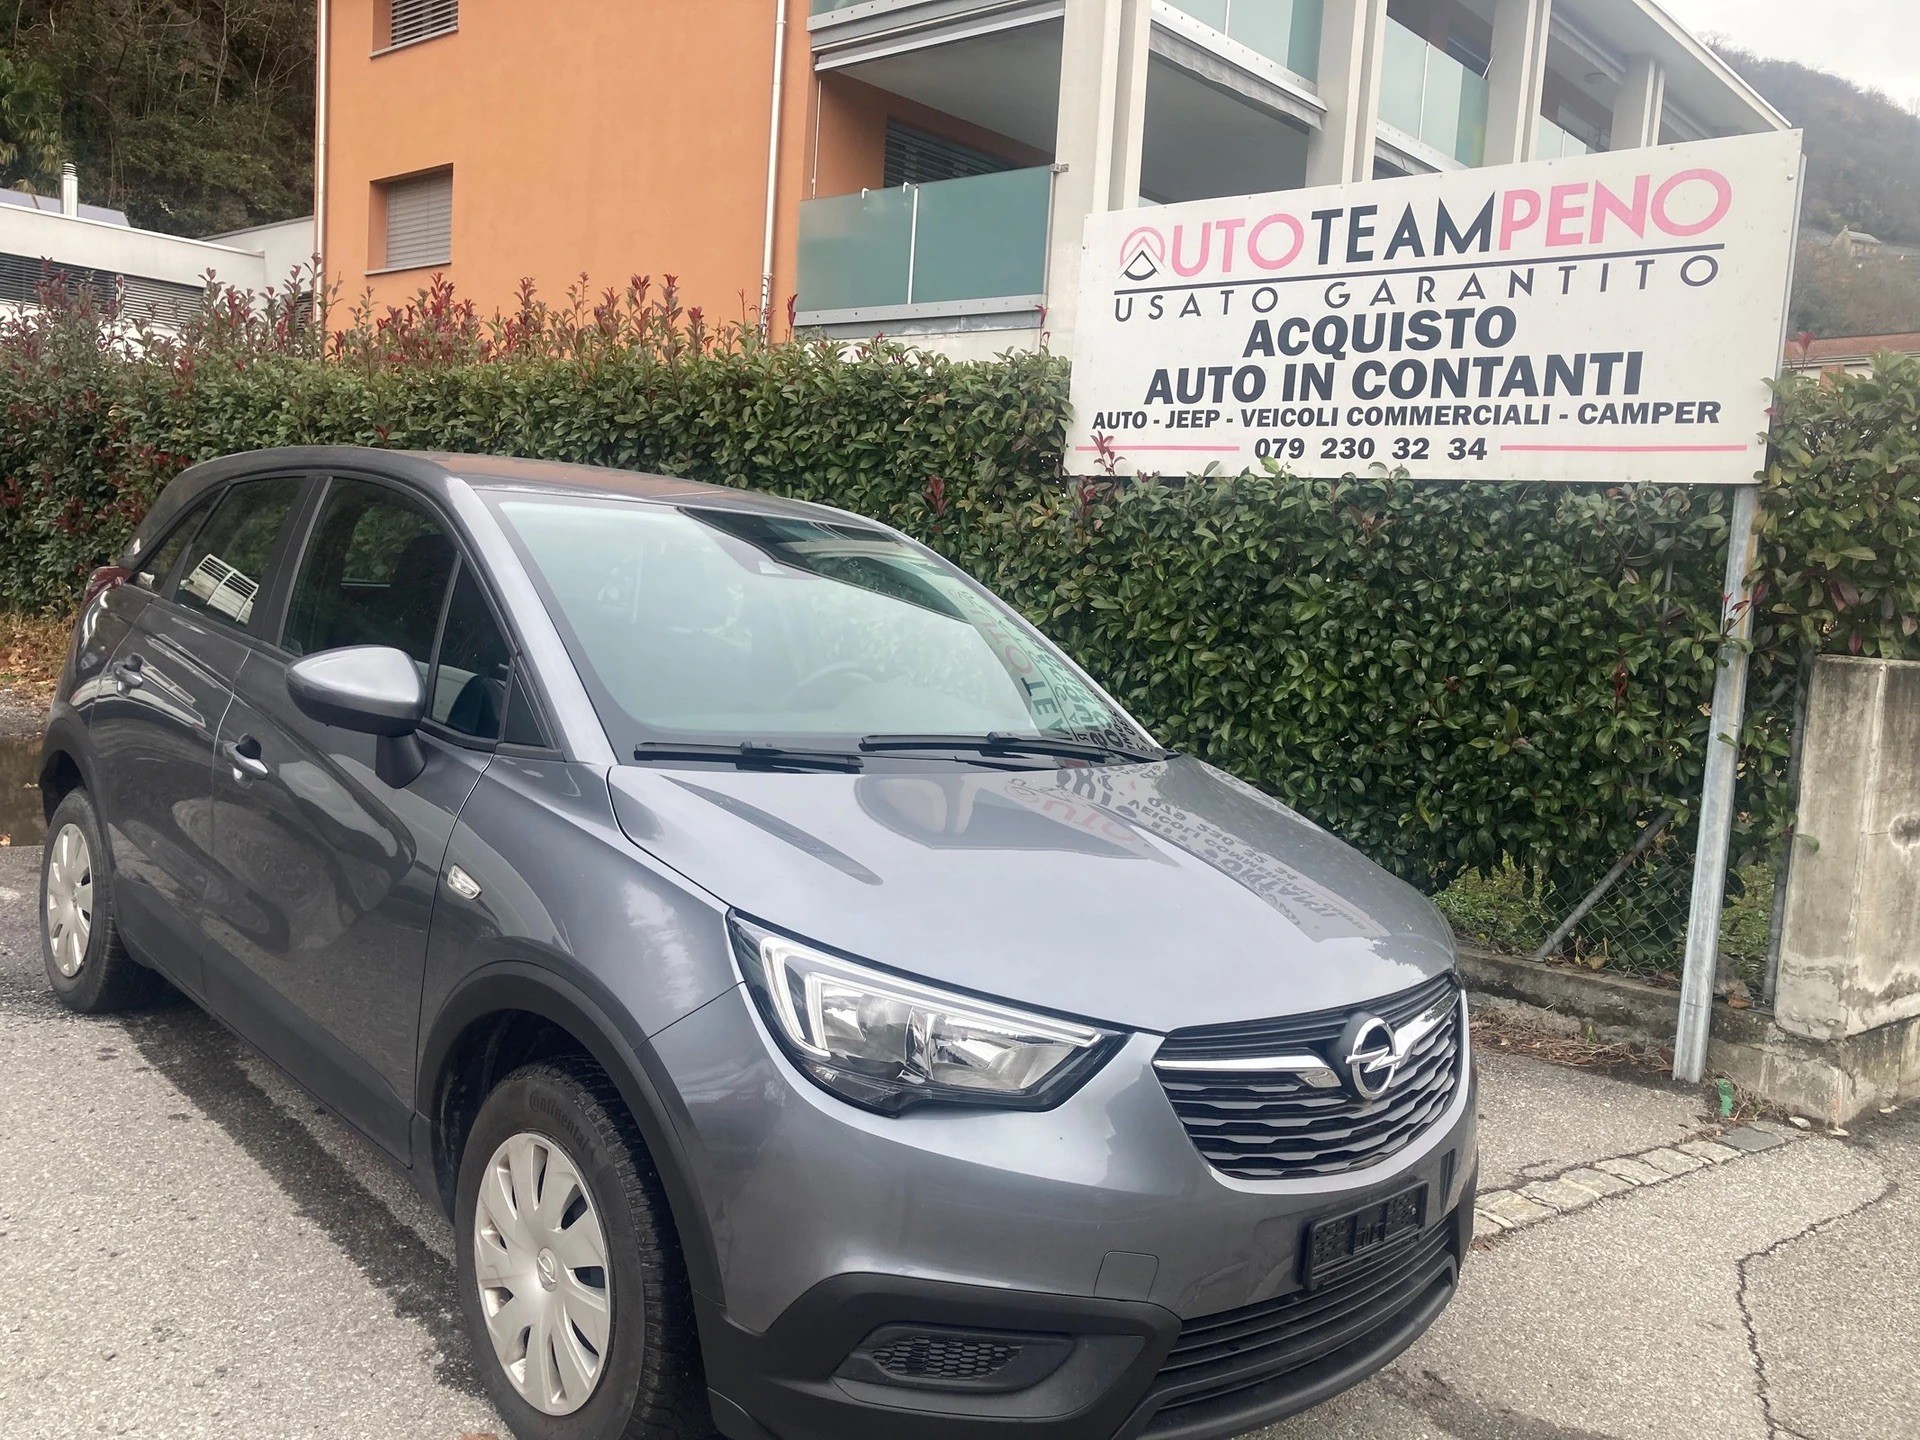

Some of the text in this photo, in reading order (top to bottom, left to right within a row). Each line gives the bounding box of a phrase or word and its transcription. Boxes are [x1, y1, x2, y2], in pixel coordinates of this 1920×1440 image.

[1114, 254, 1720, 323] USATO GARANTITO
[1242, 305, 1518, 361] ACQUISTO
[1143, 350, 1644, 405] AUTO IN CONTANTI
[1092, 410, 1148, 430] AUTO
[1165, 409, 1221, 429] JEEP
[1240, 406, 1339, 428] VEICOLI
[1345, 403, 1550, 427] COMMERCIALI
[1577, 400, 1721, 425] CAMPER
[1254, 437, 1488, 461] 079 230 32 34
